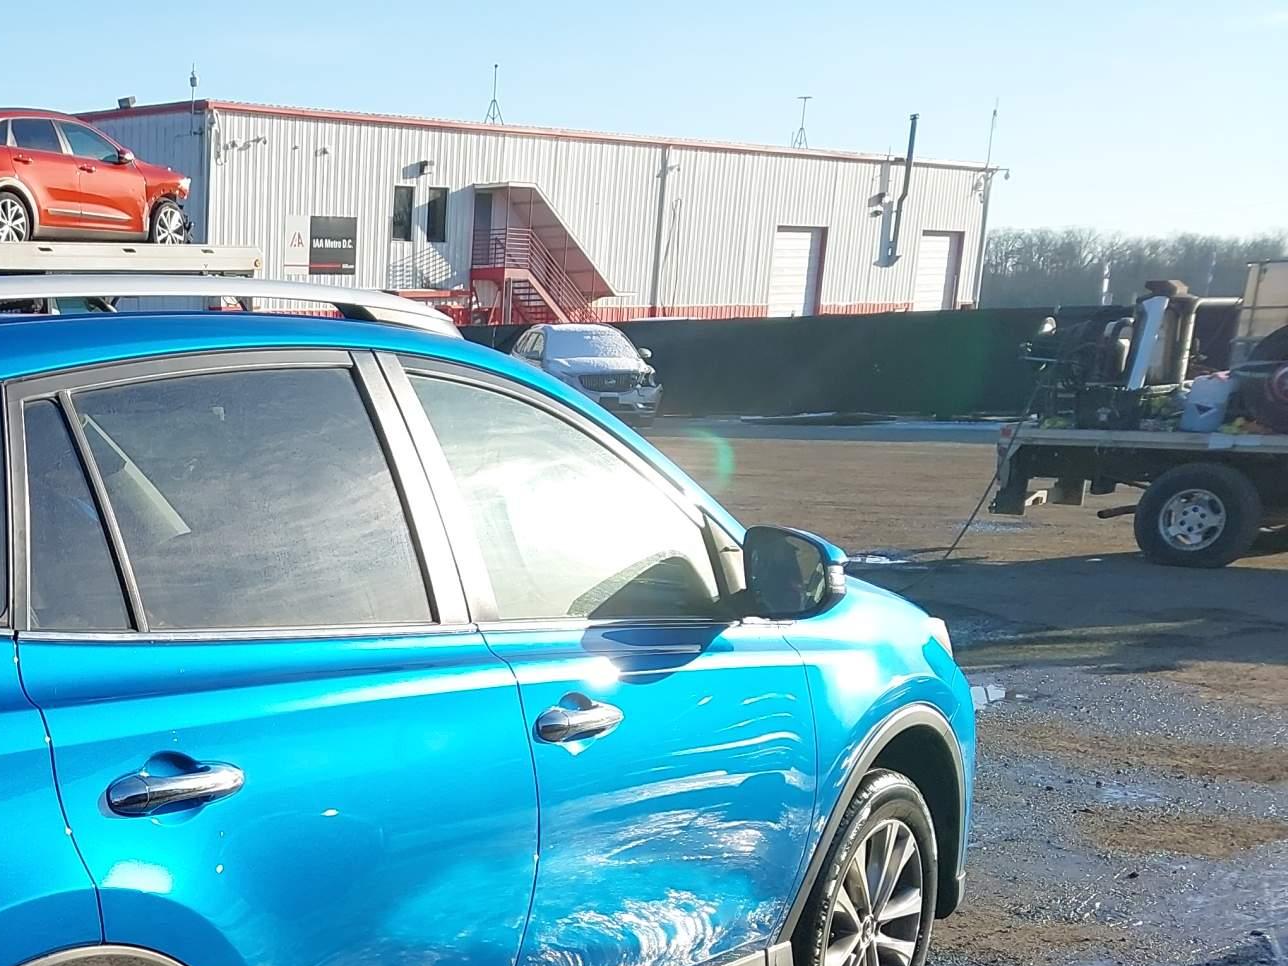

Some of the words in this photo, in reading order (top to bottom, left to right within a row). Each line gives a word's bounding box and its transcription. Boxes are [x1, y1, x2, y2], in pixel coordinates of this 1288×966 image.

[312, 238, 323, 248] IAA
[324, 238, 341, 248] Metro
[342, 239, 353, 248] D.C.
